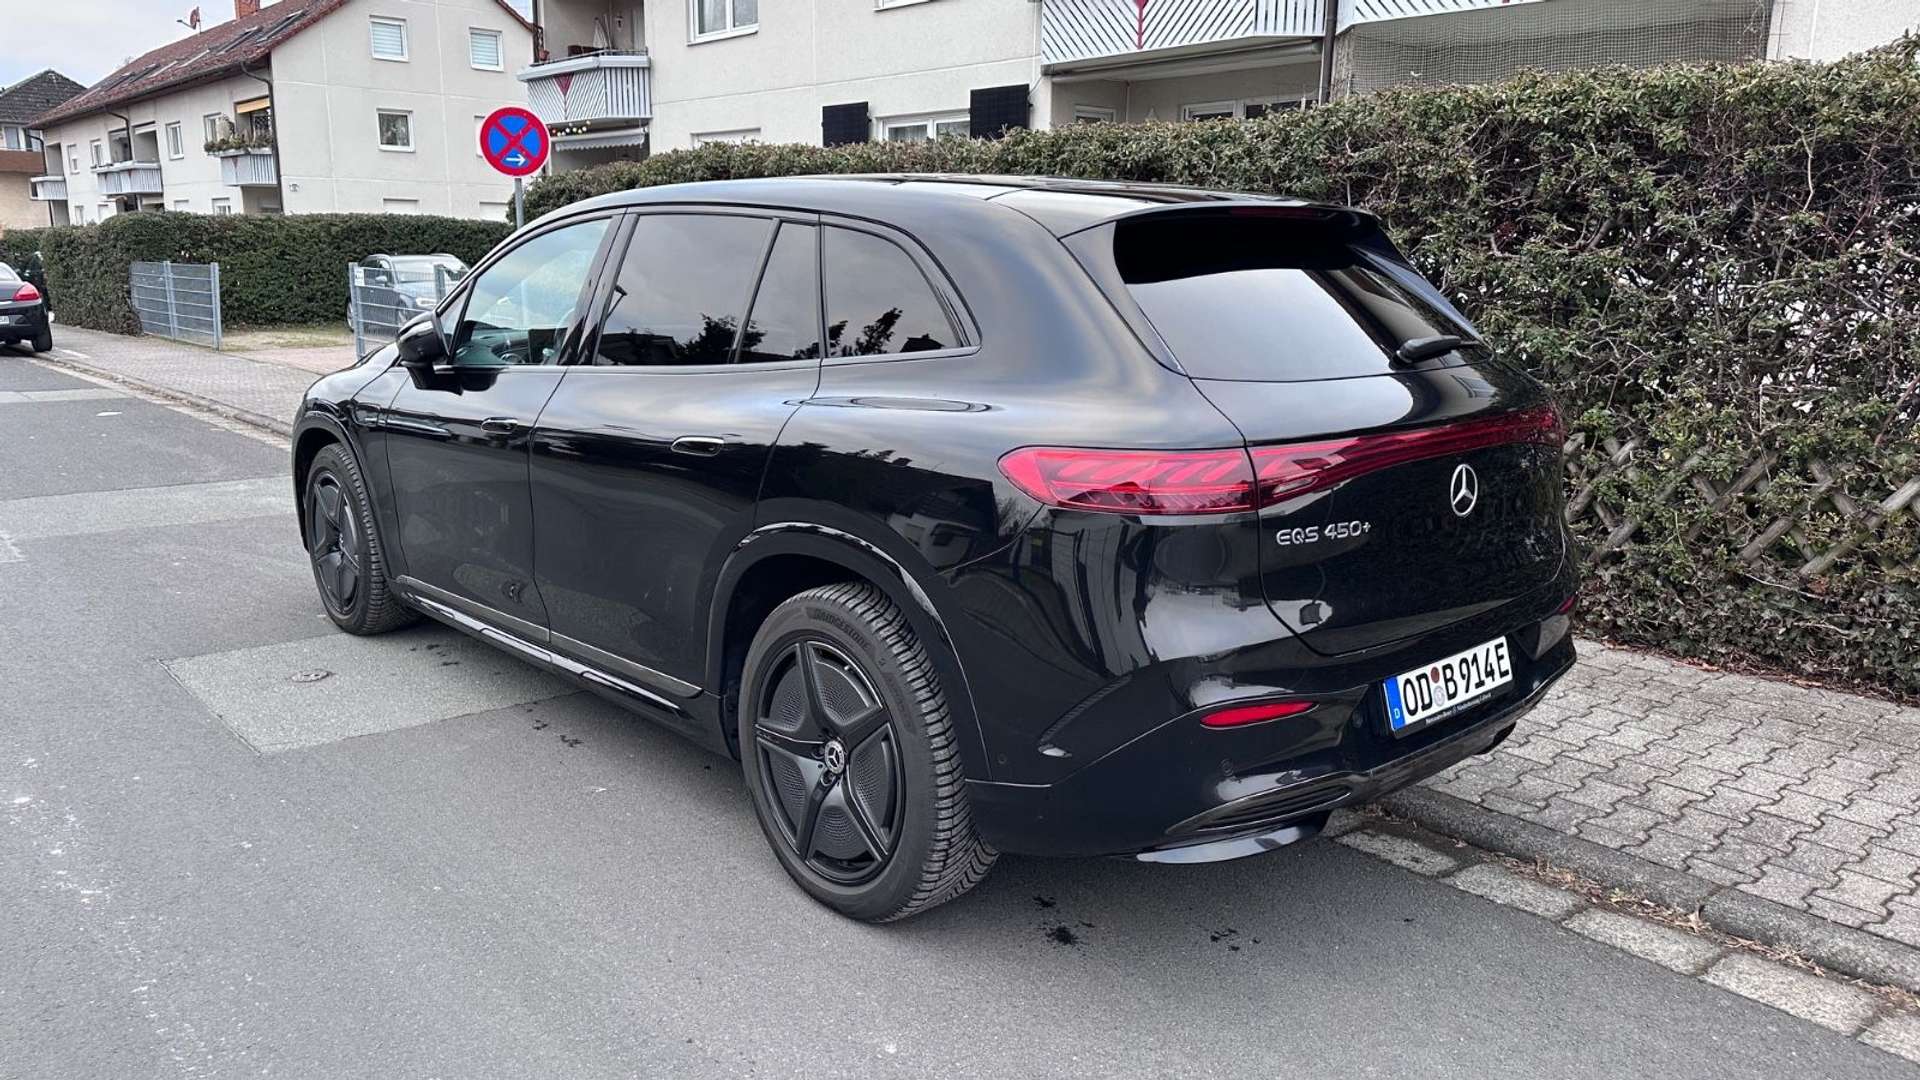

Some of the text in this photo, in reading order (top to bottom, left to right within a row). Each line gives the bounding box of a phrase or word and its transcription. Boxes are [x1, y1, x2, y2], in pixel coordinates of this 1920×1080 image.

[1276, 520, 1371, 545] EQS 450+
[1403, 672, 1433, 717] OD
